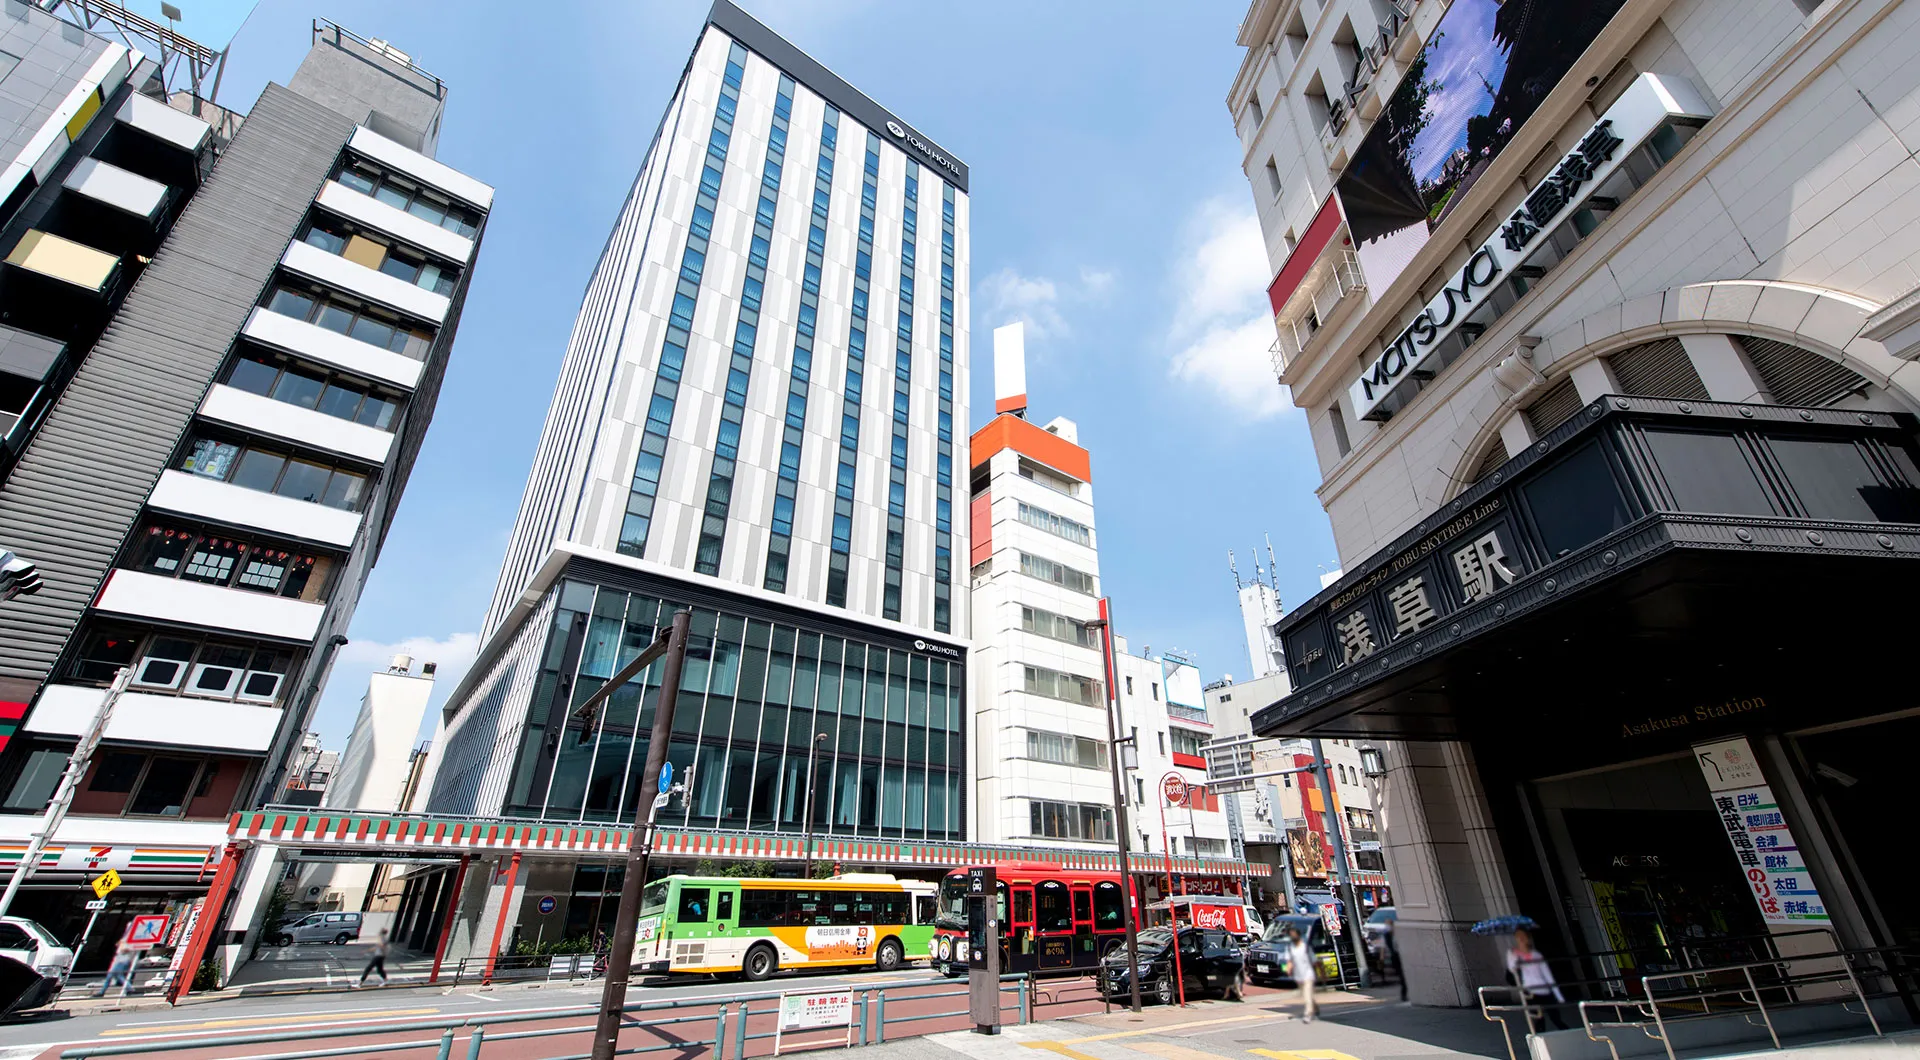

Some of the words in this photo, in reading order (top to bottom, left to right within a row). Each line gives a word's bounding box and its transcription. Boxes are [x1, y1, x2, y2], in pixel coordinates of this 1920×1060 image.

[906, 133, 931, 155] TOBU
[932, 151, 960, 176] HOTEL
[1500, 119, 1624, 252] 松屋浅草
[1391, 549, 1420, 574] TOBU
[1421, 513, 1474, 554] SKYTREE
[1474, 499, 1500, 522] Line
[1330, 568, 1389, 611] 東武スカイツリーライン
[1336, 531, 1516, 669] 浅草駅
[926, 643, 941, 652] TOBU
[941, 648, 958, 657] HOTEL
[1622, 715, 1690, 738] Asakusa
[1694, 697, 1767, 721] Station
[1737, 793, 1759, 806] 日光
[1746, 812, 1782, 827] 鬼怒川温泉
[1755, 835, 1778, 847] 会津
[1612, 855, 1660, 867] ACESS
[1715, 797, 1780, 914] 東武電車のりば
[1764, 855, 1788, 868] 館林
[1773, 878, 1797, 890] 太田
[807, 996, 849, 1006] 駐輪禁止
